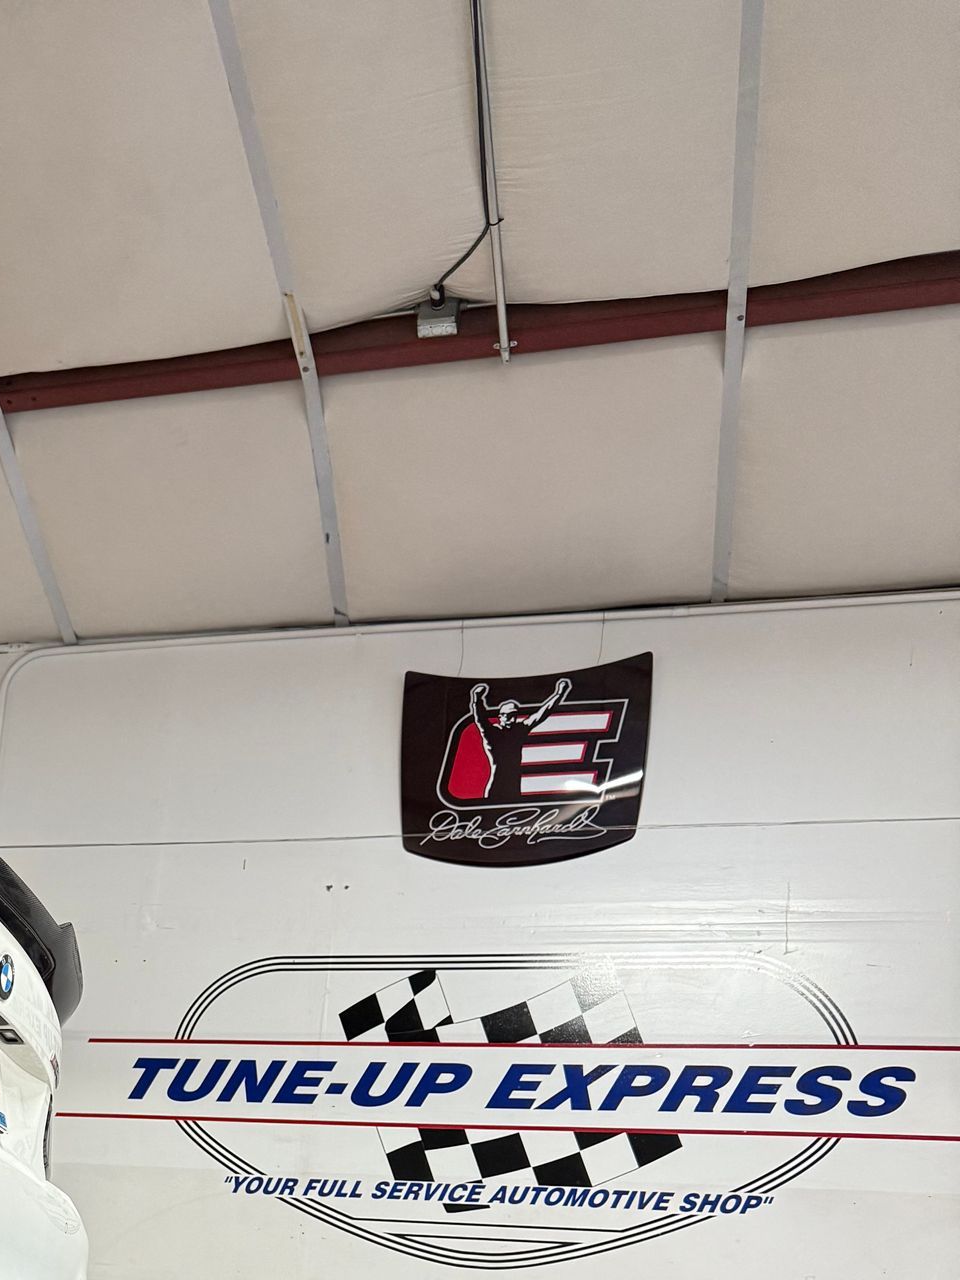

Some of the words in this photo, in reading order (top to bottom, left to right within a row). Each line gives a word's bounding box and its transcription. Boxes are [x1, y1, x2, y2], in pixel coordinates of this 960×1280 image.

[420, 810, 487, 846] Dale
[127, 1057, 473, 1109] TUNE-UP
[485, 1063, 916, 1117] EXPRESS
[224, 1176, 298, 1196] "YOUR
[302, 1178, 363, 1199] FULL
[371, 1181, 486, 1204] SERVICE
[490, 1185, 674, 1212] AUTOMOTIVE
[679, 1192, 775, 1215] SHOP"
